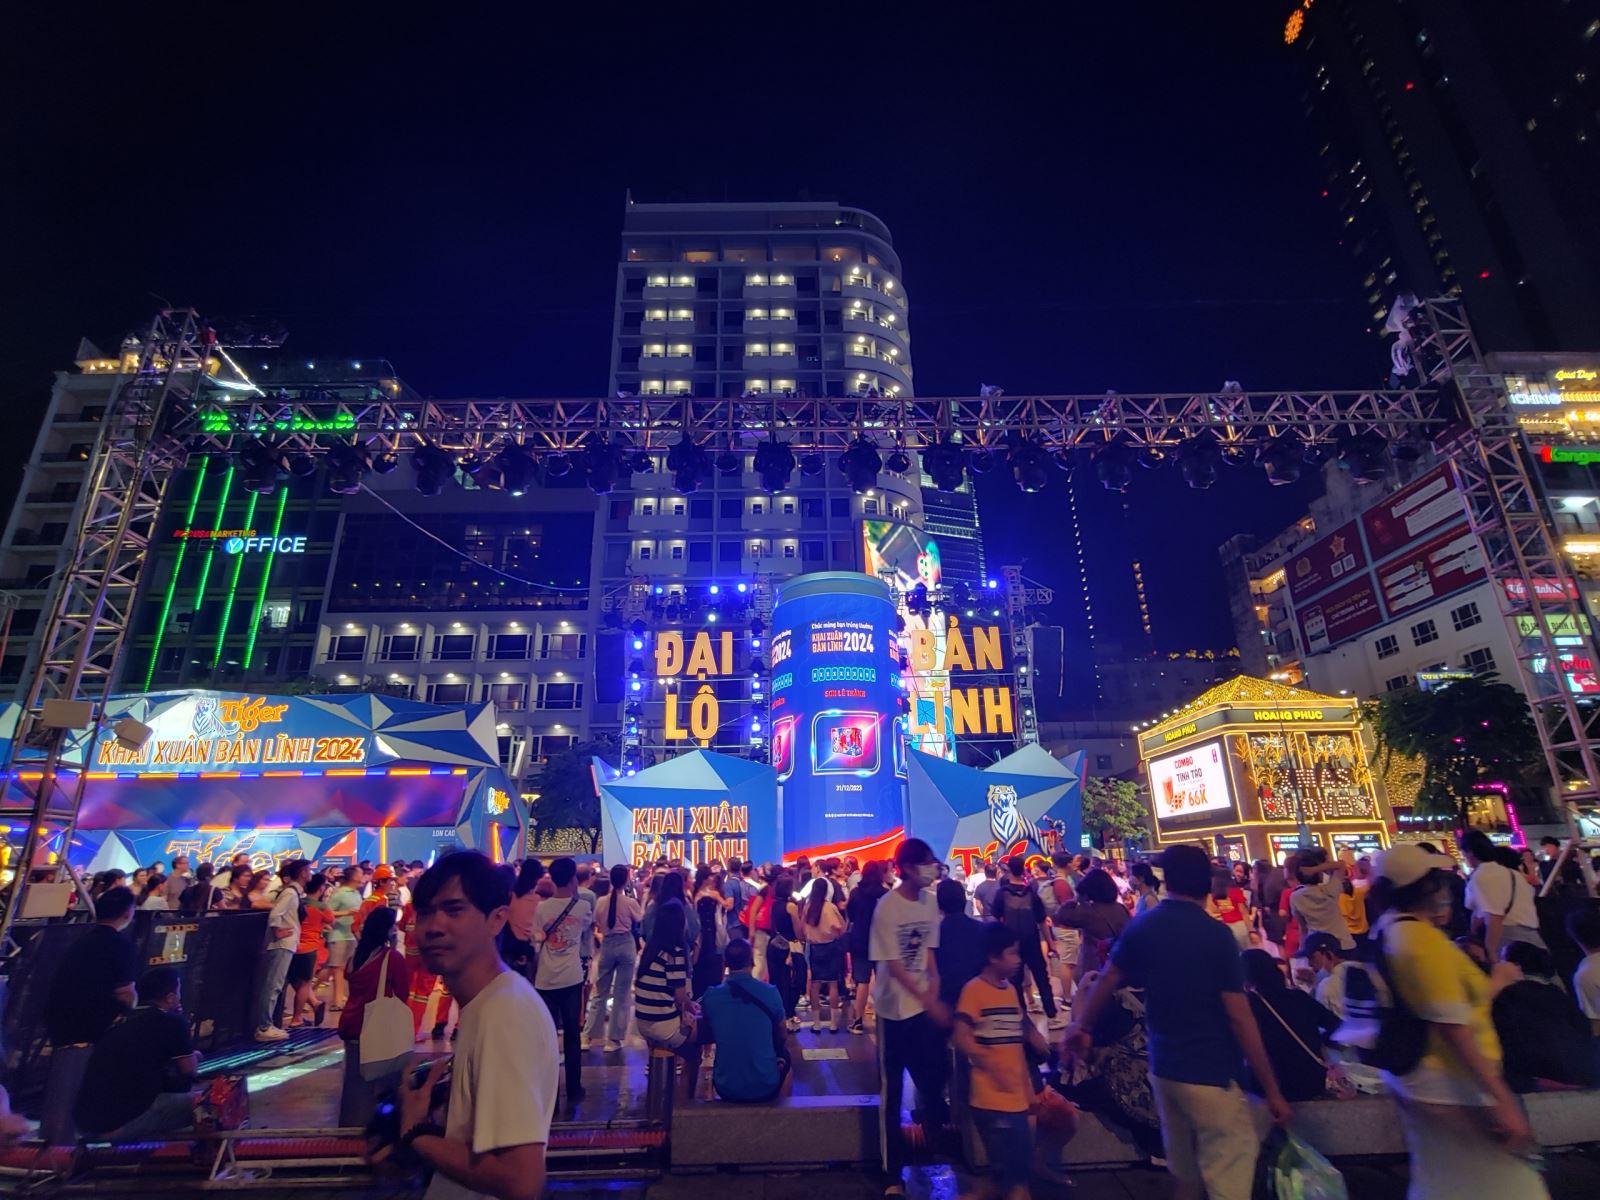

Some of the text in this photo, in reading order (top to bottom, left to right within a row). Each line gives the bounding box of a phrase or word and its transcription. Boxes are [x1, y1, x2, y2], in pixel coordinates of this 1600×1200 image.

[811, 630, 843, 642] KHAI XUÂN
[843, 631, 874, 653] 2024
[910, 615, 1003, 671] BẢN
[655, 631, 733, 681] ĐẠI
[220, 697, 289, 732] Tiger
[665, 684, 719, 748] LỘ
[908, 680, 1013, 735] LĨNH
[153, 734, 211, 764] XUÂN
[213, 732, 262, 763] BẢN
[262, 733, 316, 763] LĨNH
[313, 737, 367, 762] 2024
[1174, 755, 1194, 769] COMBO
[1277, 768, 1351, 788] XMAS
[1188, 787, 1209, 807] 66K
[633, 800, 748, 835] KHAI XUÂN
